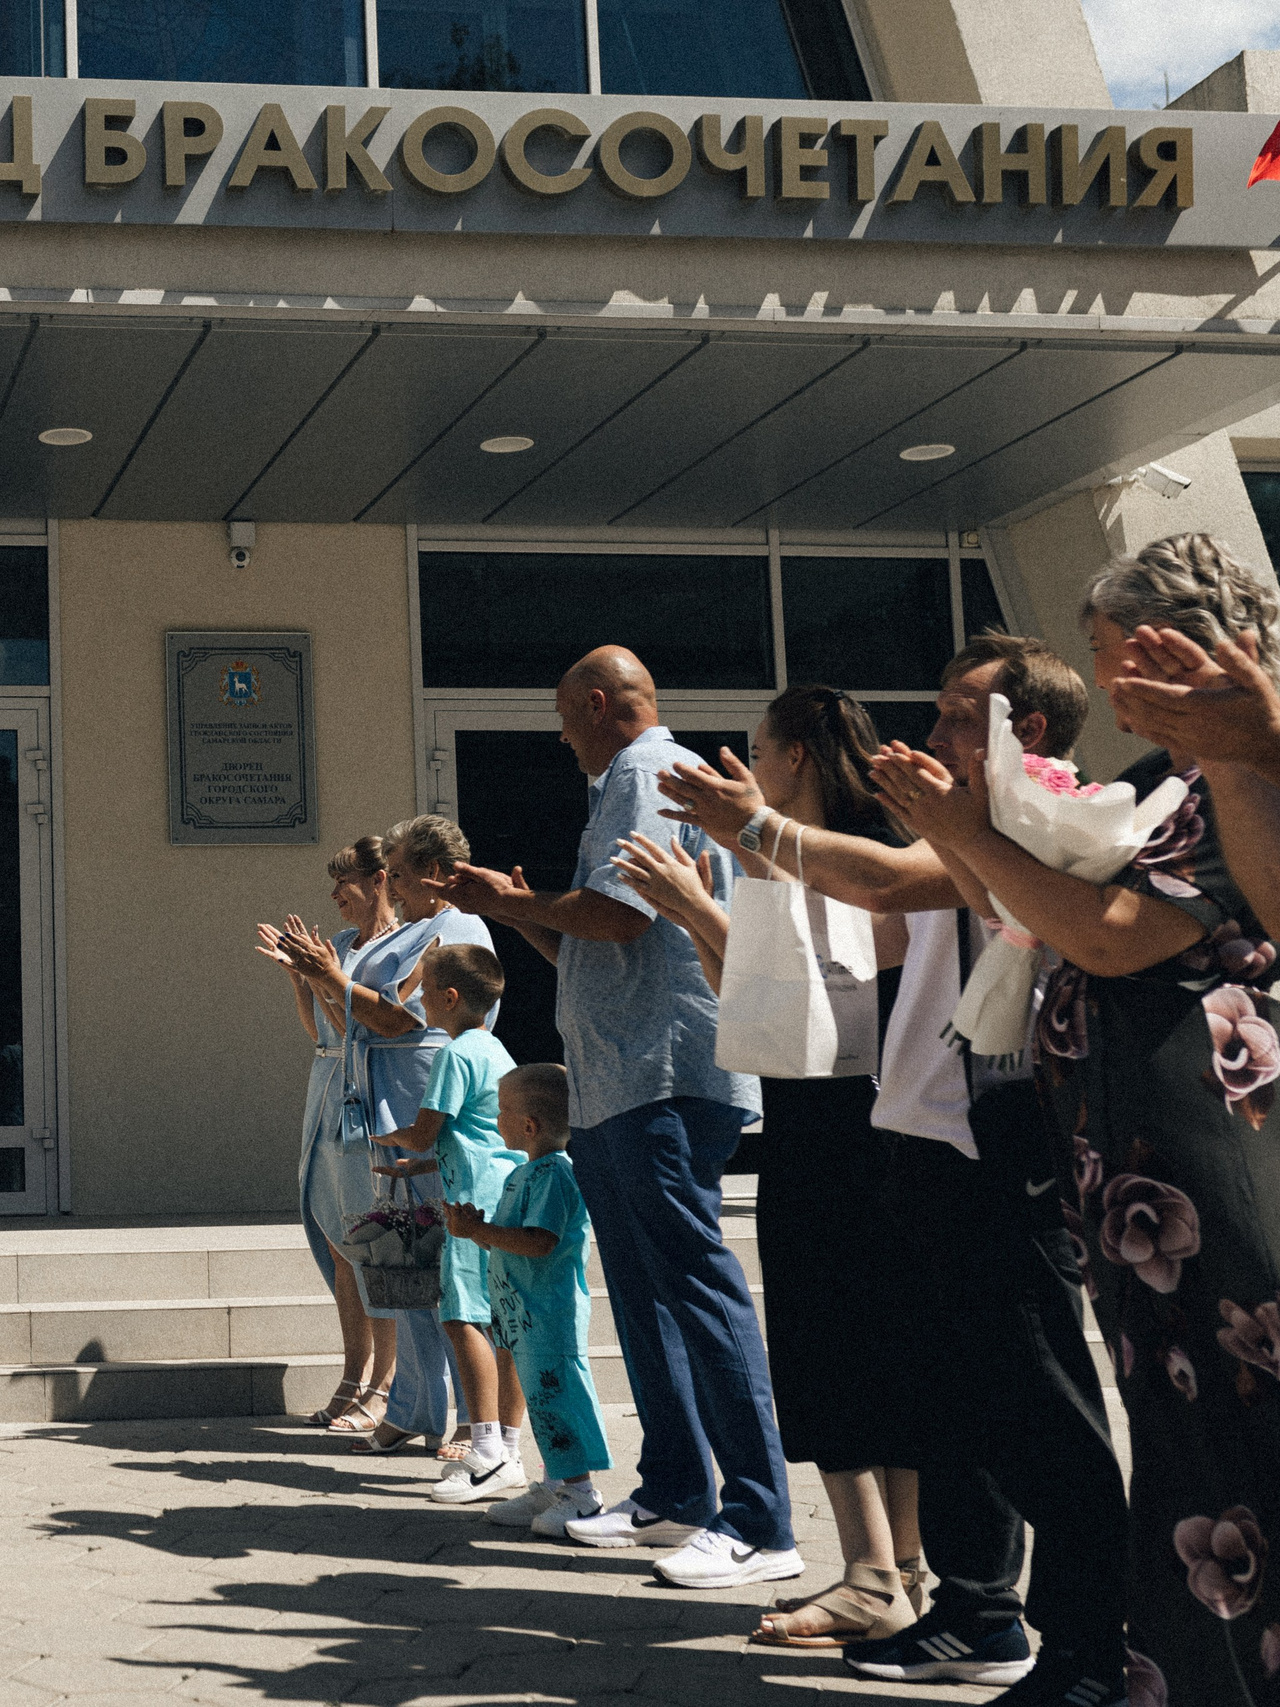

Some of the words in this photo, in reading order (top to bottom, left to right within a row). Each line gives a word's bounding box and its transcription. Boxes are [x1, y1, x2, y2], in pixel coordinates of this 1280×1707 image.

[83, 97, 1194, 209] БРАКОСОЧЕТАНИЯ
[221, 762, 263, 771] ДВОРЕЦ
[193, 773, 292, 782] БРАКОСОЧЕТАНИЯ
[207, 785, 278, 794] ГОРОДСКОГО
[200, 796, 241, 805] ОКРУГА
[244, 796, 286, 805] САМАРА
